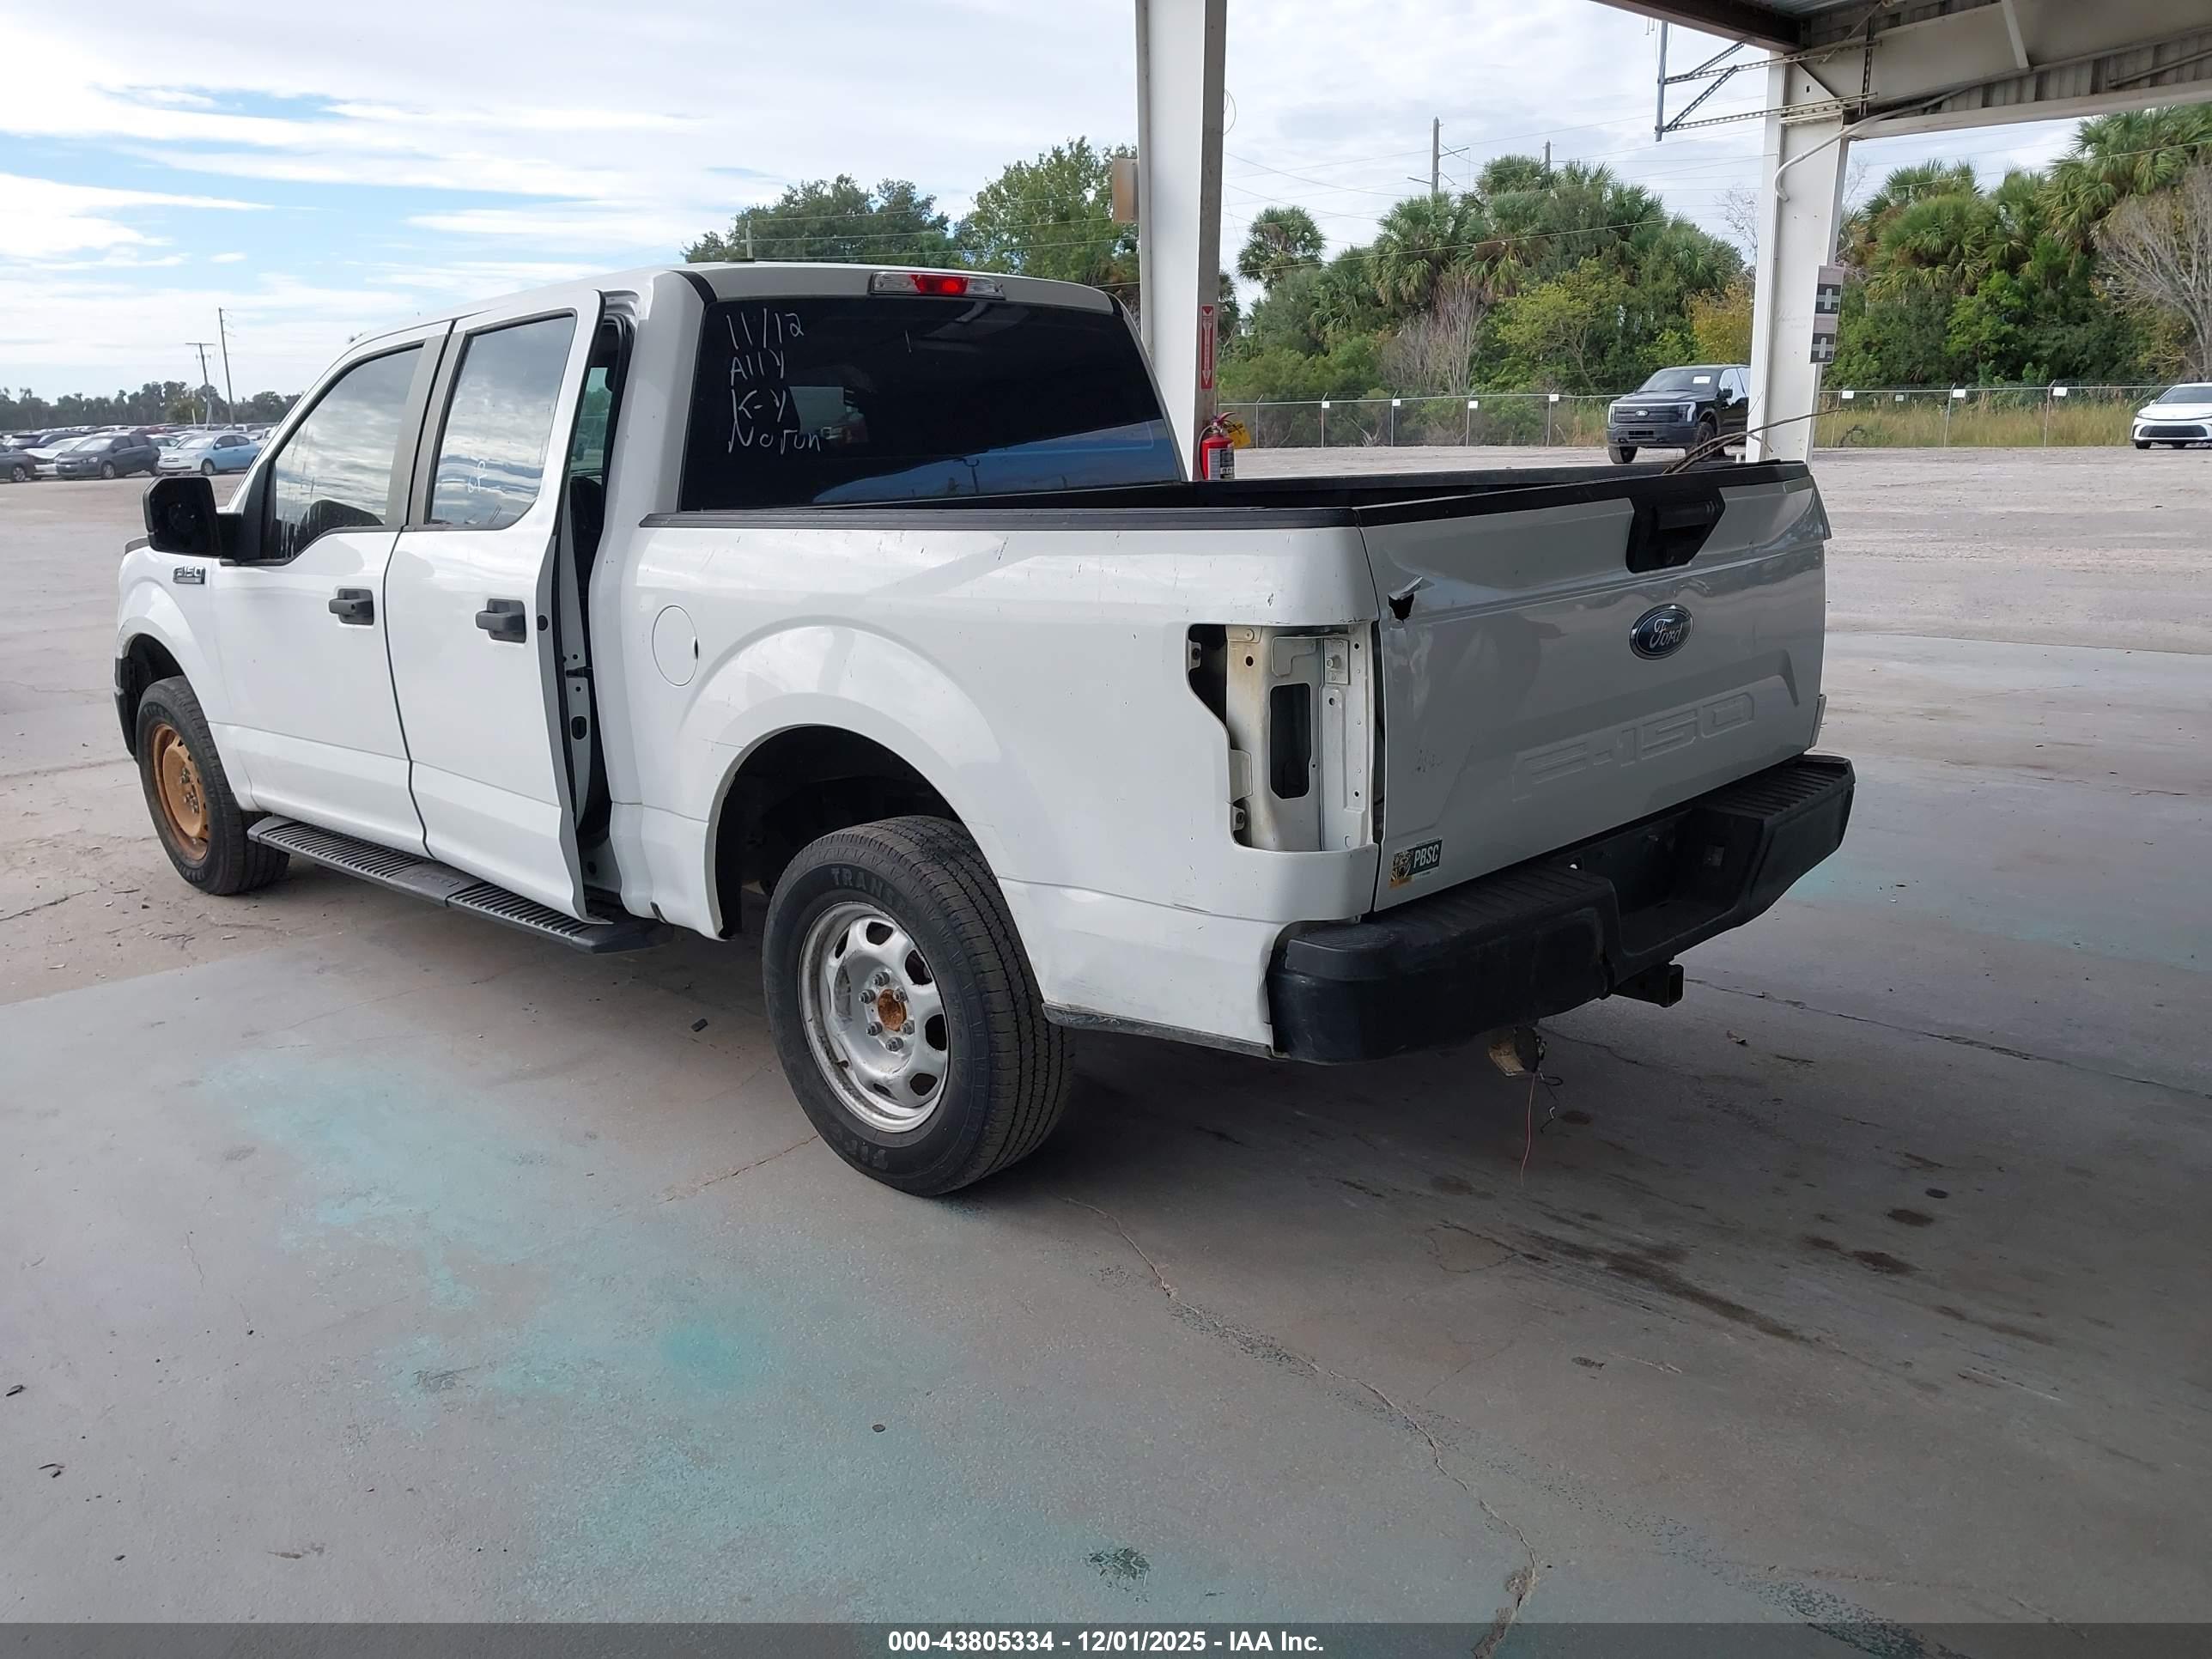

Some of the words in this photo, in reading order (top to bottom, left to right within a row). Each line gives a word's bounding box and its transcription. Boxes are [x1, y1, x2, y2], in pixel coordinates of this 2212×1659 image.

[726, 307, 805, 349] 11/12
[1649, 618, 1683, 648] Ford
[1511, 691, 1755, 801] F-150
[1413, 844, 1439, 869] PBSC
